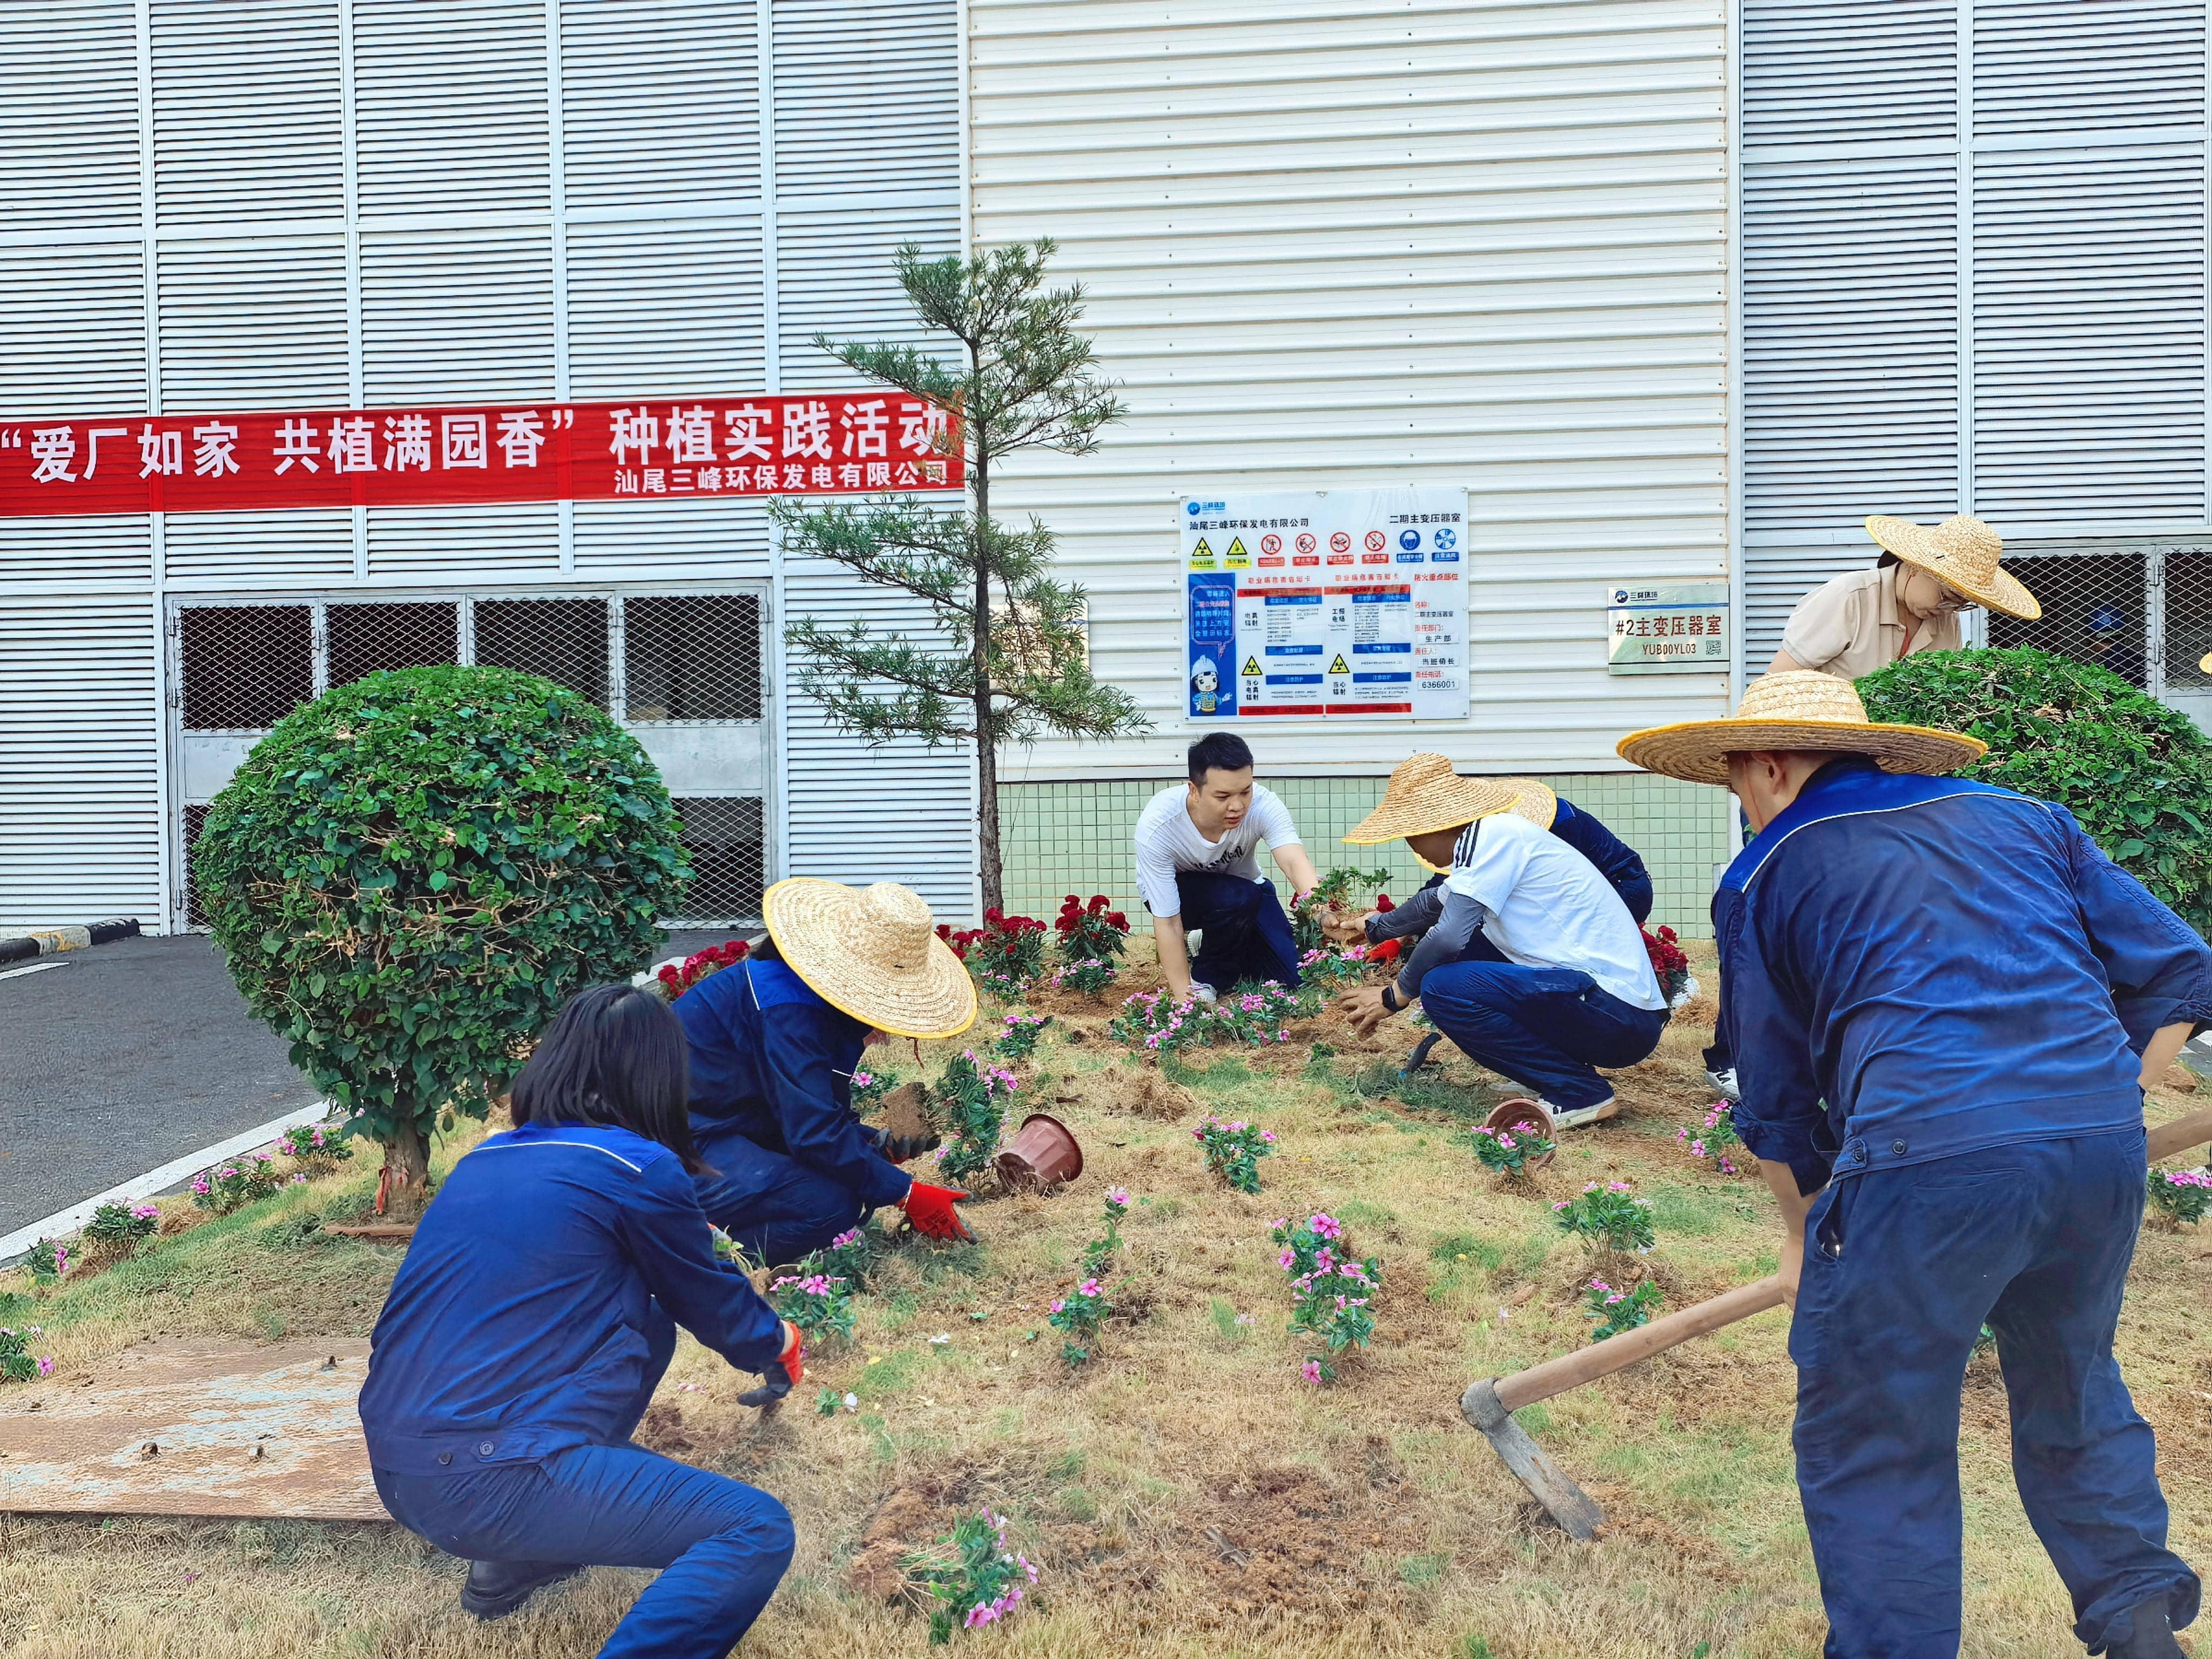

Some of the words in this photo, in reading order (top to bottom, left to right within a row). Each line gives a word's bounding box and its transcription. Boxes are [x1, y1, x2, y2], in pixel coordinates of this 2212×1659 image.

[1, 421, 240, 484] “爱厂如家
[273, 409, 574, 475] 共植满园香”
[610, 399, 947, 466] 种植实践活动
[614, 460, 947, 494] 汕尾三峰环保发电有限公司
[1189, 518, 1310, 531] 汕尾三峰环保发电有限公司
[1390, 513, 1461, 524] 二期主变压器室
[1615, 615, 1722, 637] #2主变压器室
[1425, 635, 1452, 643] 生产部
[1422, 657, 1455, 665] 当班值长
[1421, 680, 1455, 689] 6366001
